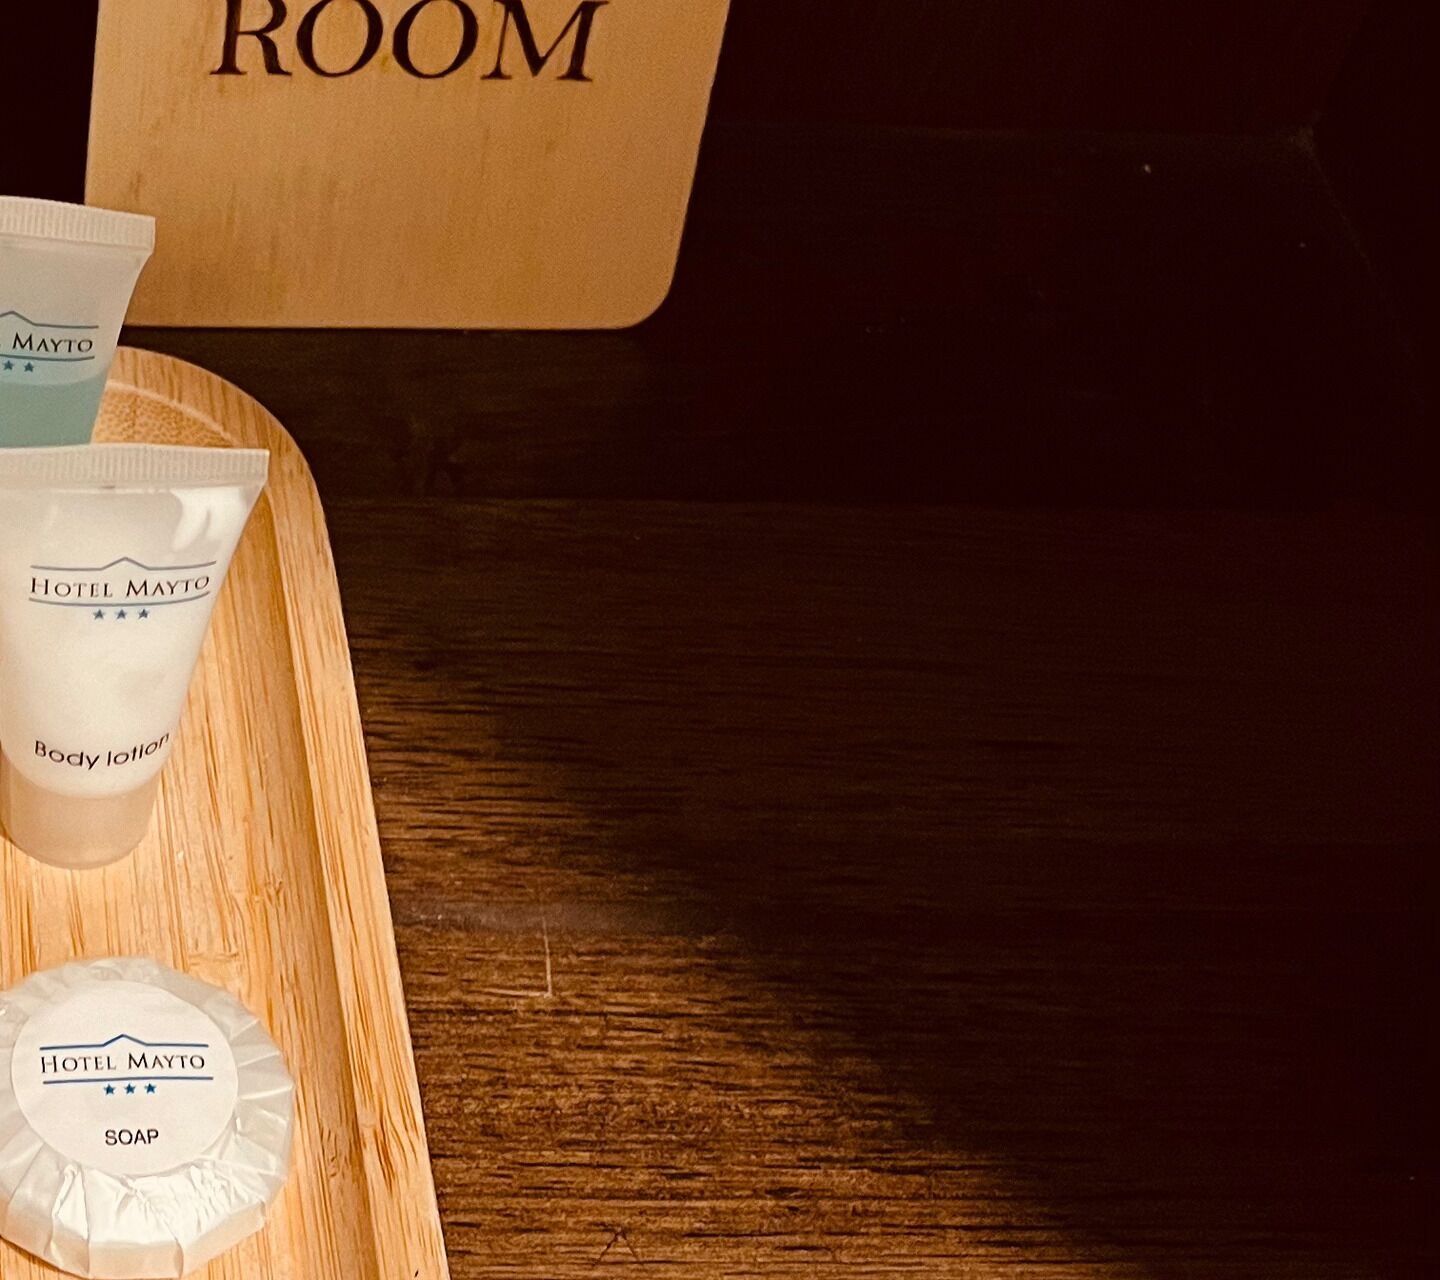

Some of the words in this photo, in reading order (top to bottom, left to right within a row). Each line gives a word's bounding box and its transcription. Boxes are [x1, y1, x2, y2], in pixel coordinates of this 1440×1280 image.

[13, 330, 94, 354] MAYTO
[30, 576, 114, 599] HOTEL
[125, 574, 211, 598] MAYTO
[34, 739, 100, 771] Body
[107, 731, 170, 767] lotion
[40, 1055, 118, 1074] HOTEL
[127, 1053, 206, 1071] MAYTO
[104, 1128, 160, 1146] SOAP
